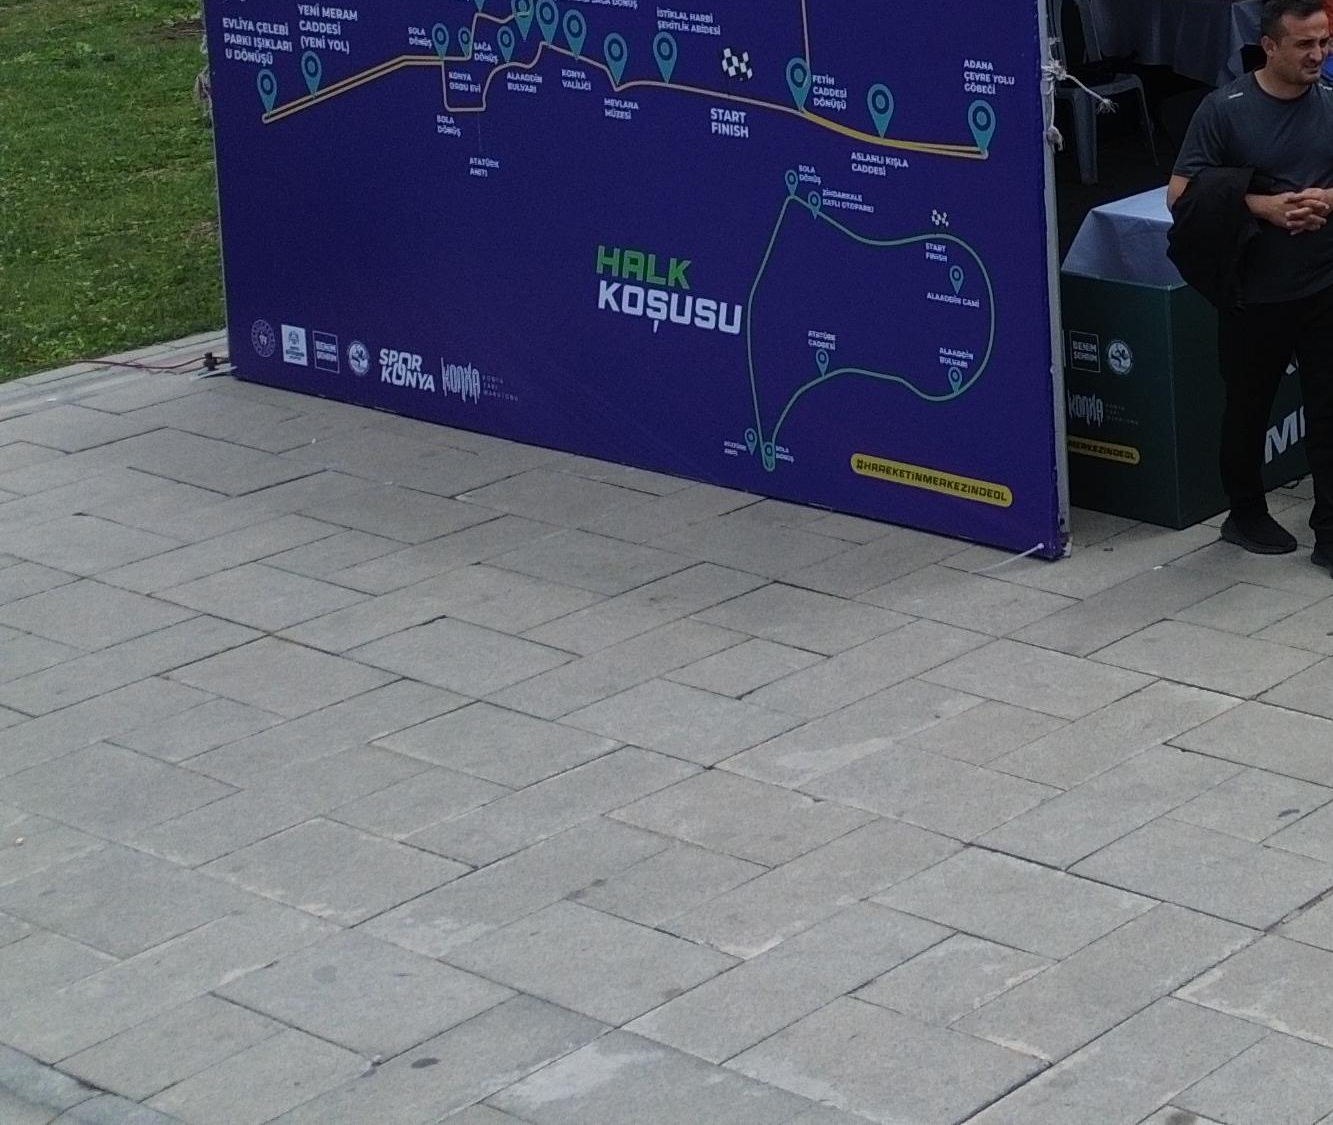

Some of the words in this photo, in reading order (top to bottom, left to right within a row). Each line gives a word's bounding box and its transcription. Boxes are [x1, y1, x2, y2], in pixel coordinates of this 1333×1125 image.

[298, 3, 320, 17] YENİ
[322, 6, 358, 21] MERAM
[222, 16, 255, 31] EVLİYA
[256, 22, 289, 36] ÇELEBİ
[299, 20, 341, 35] CADDESİ
[224, 33, 252, 46] PARKI
[300, 35, 326, 49] (YENİ
[327, 38, 350, 54] YOL)
[225, 49, 232, 59] U
[234, 48, 273, 66] DÖNÜŞÜ
[710, 107, 747, 124] START
[711, 122, 749, 138] FINISH
[596, 245, 692, 290] HALK
[597, 279, 743, 335] KOŞUSU
[380, 348, 423, 372] SPOR
[381, 362, 436, 393] KONYA
